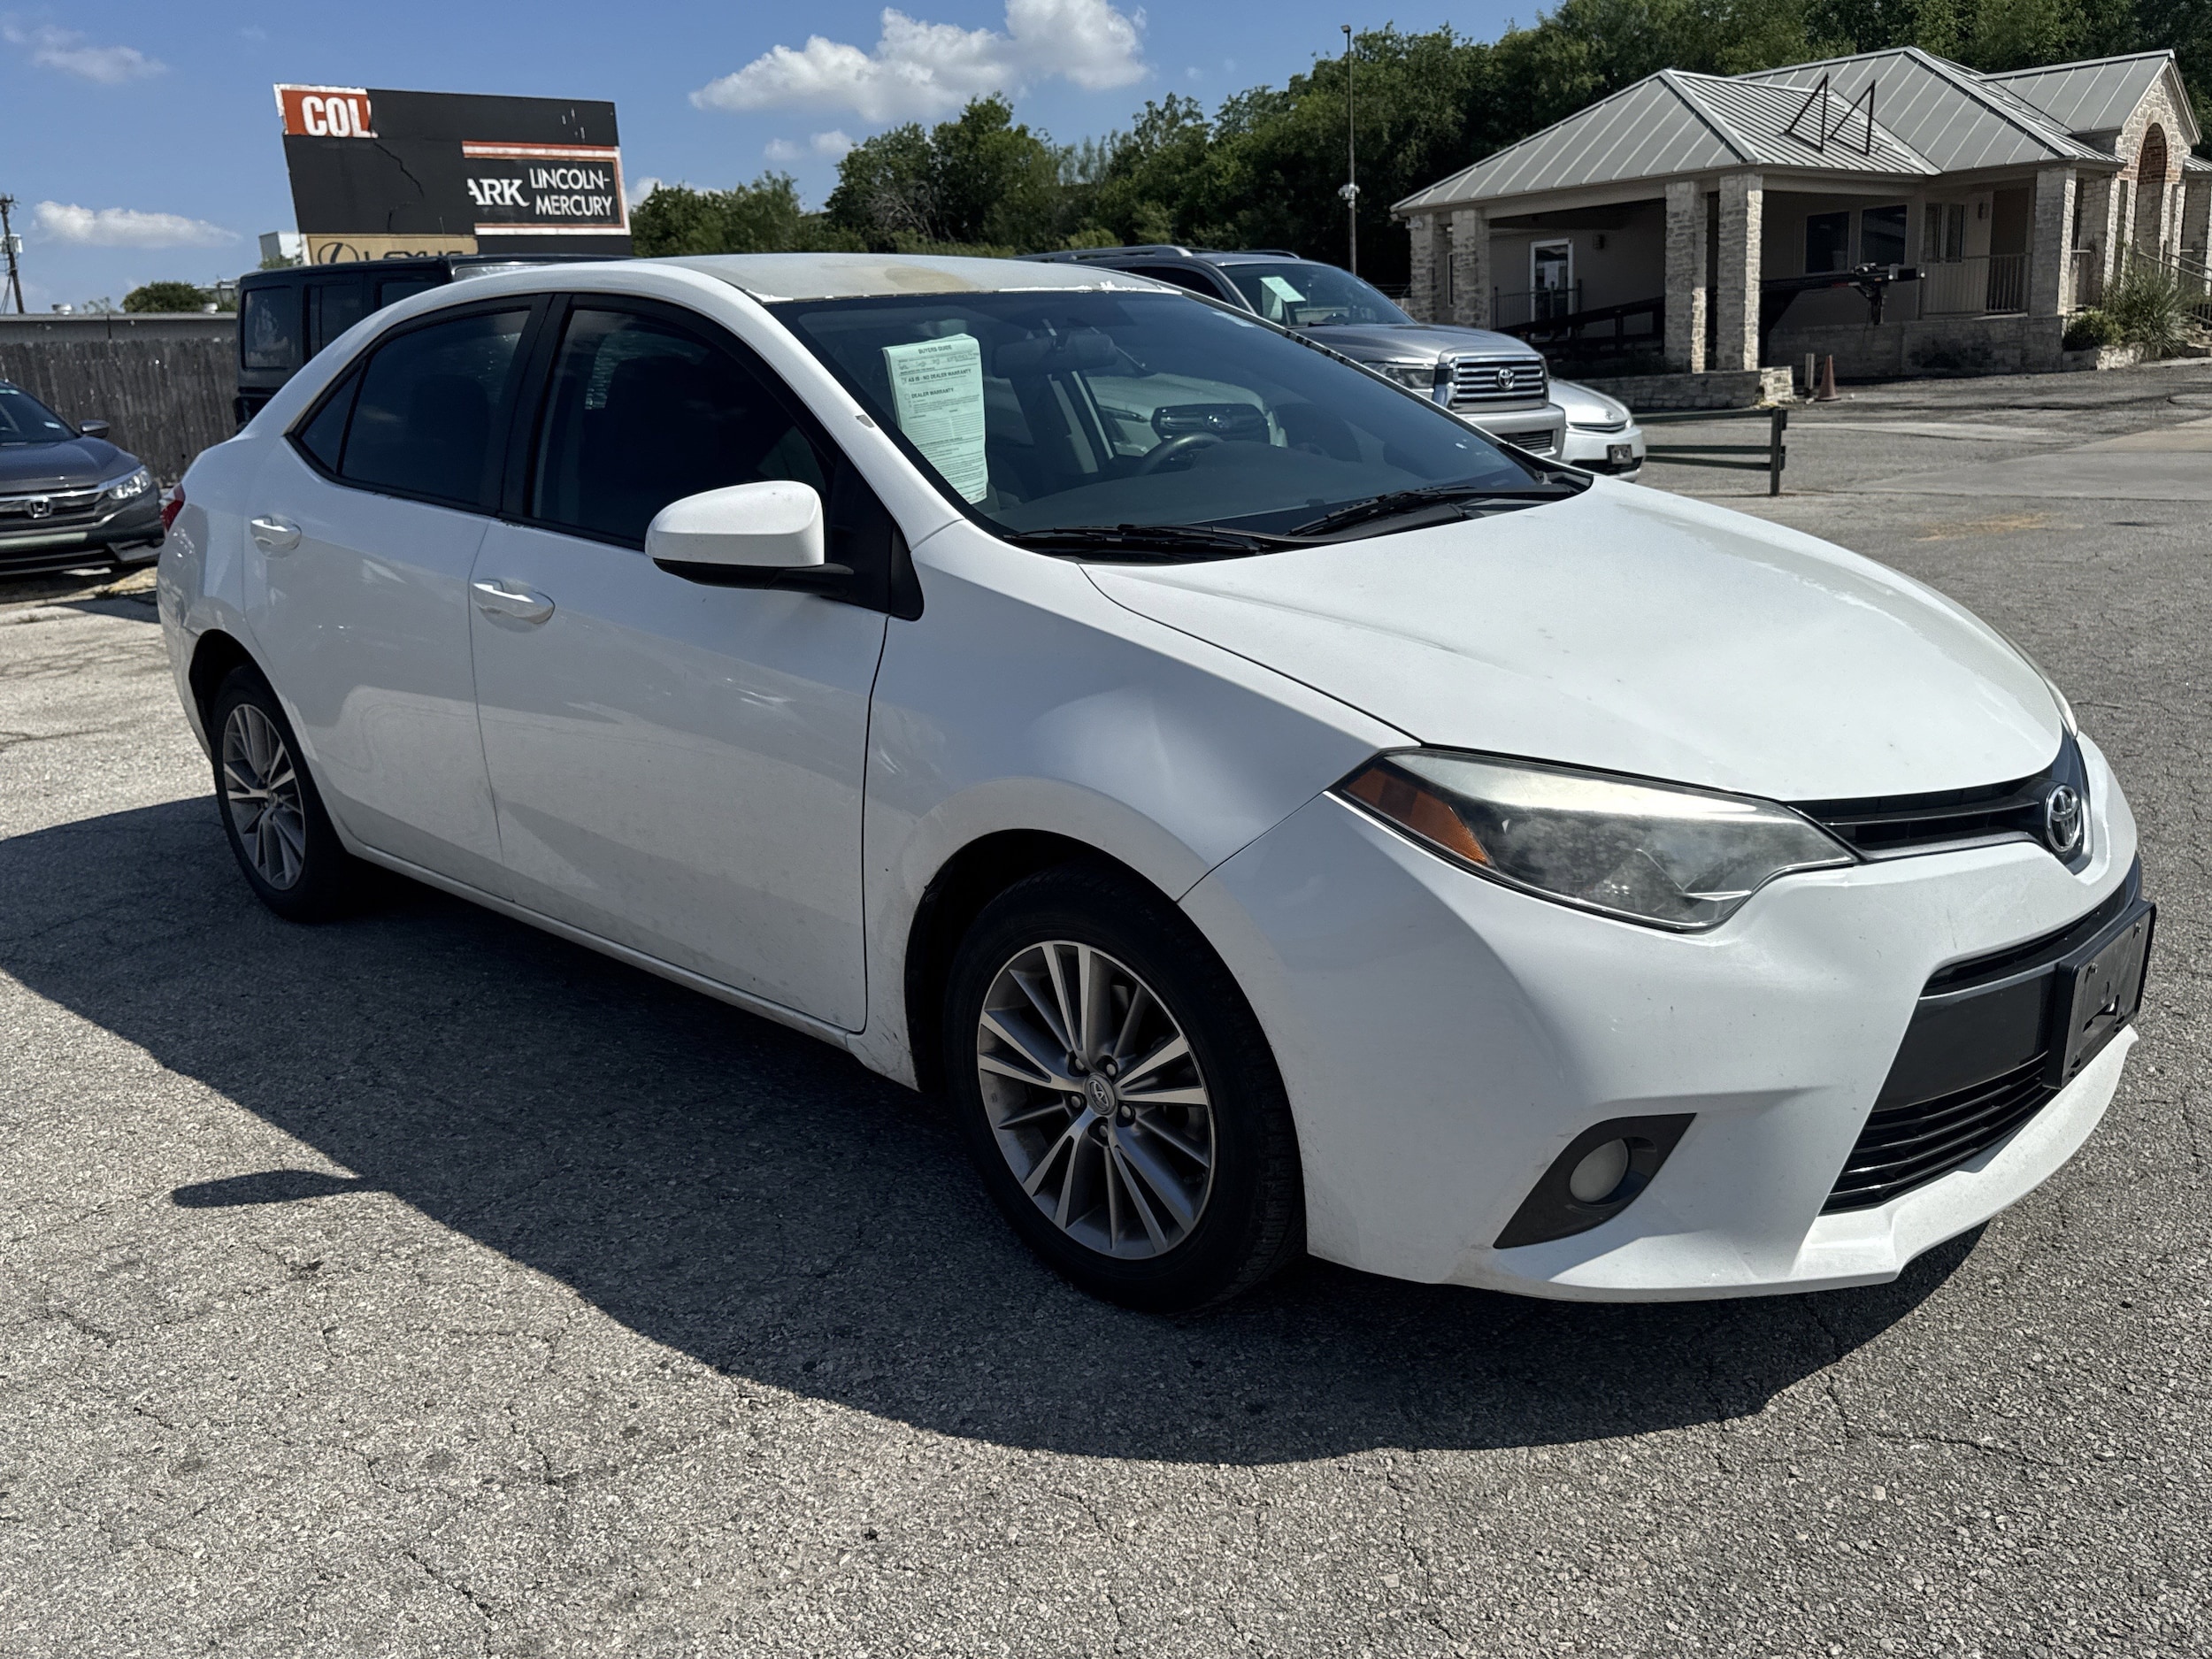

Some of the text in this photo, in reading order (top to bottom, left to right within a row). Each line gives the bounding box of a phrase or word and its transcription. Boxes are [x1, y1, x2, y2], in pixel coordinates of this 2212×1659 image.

[302, 96, 378, 138] COL
[529, 168, 611, 190] LINCOLN-
[535, 195, 612, 216] MERCURY
[948, 368, 972, 377] WARRANTY
[911, 390, 929, 399] DEALER
